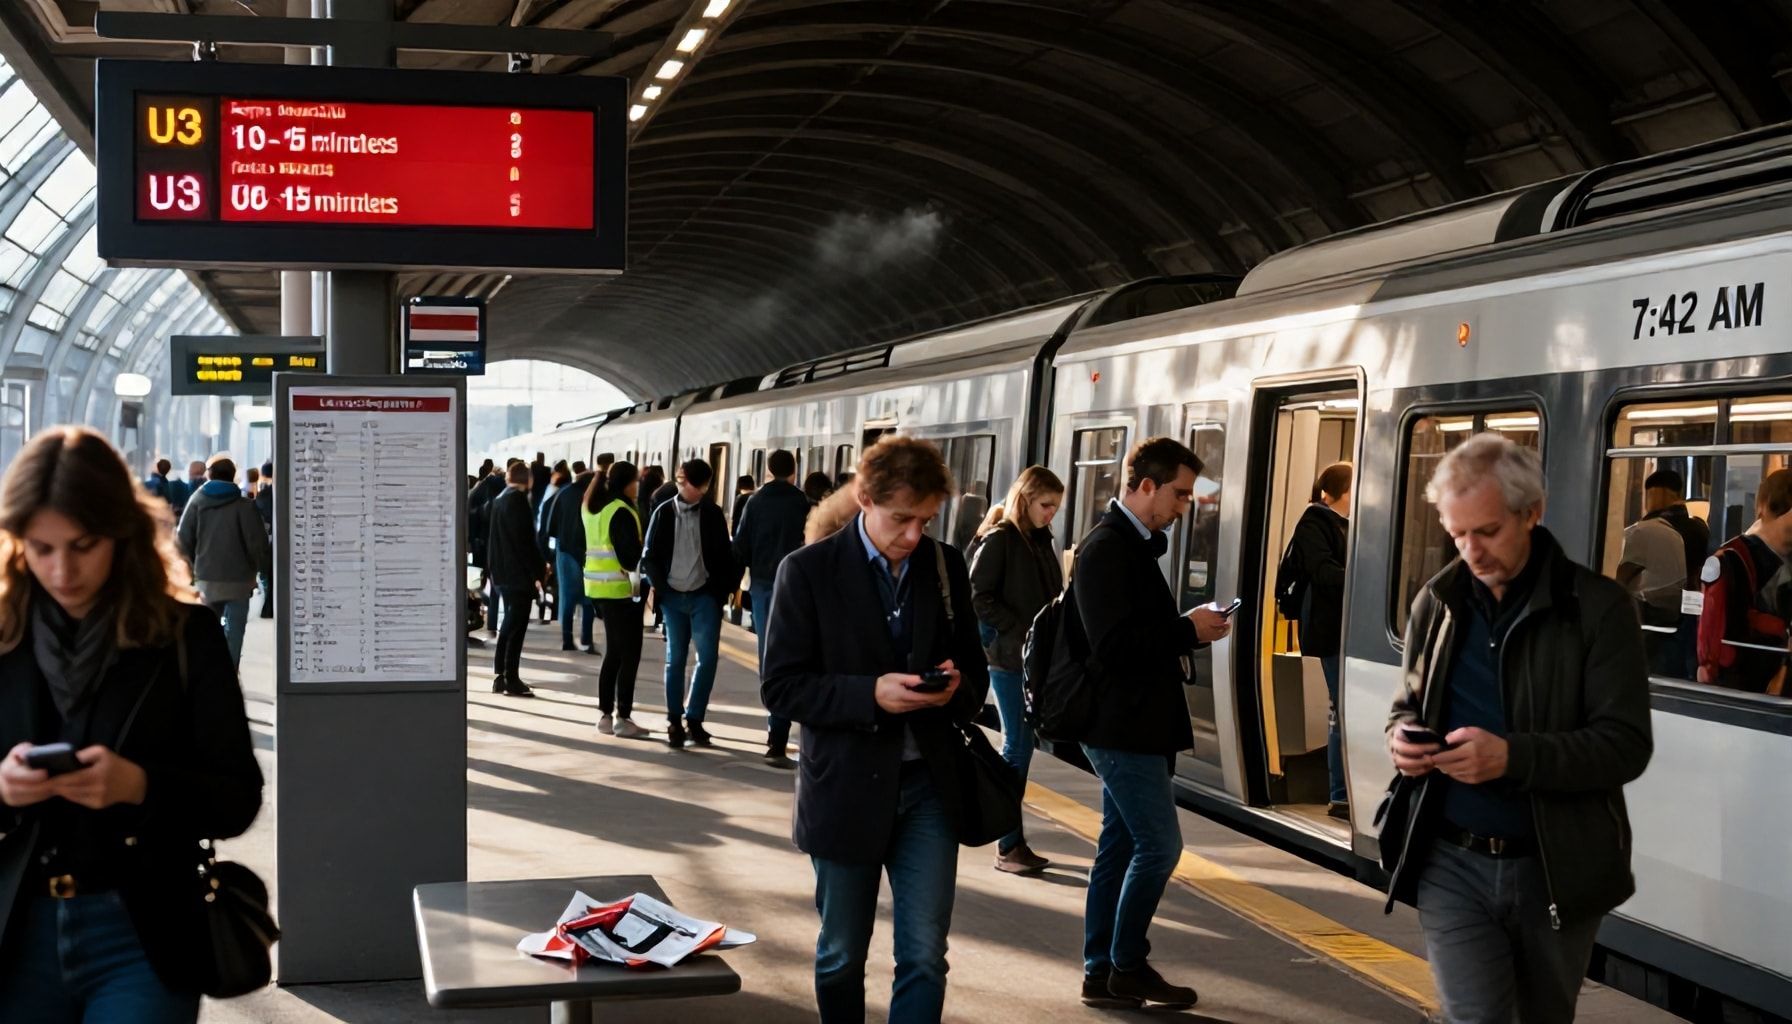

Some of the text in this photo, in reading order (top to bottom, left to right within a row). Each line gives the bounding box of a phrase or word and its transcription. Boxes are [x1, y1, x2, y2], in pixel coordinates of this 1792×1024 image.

[148, 106, 202, 146] U3
[149, 174, 201, 212] U3
[1632, 282, 1765, 340] 7:42 AM
